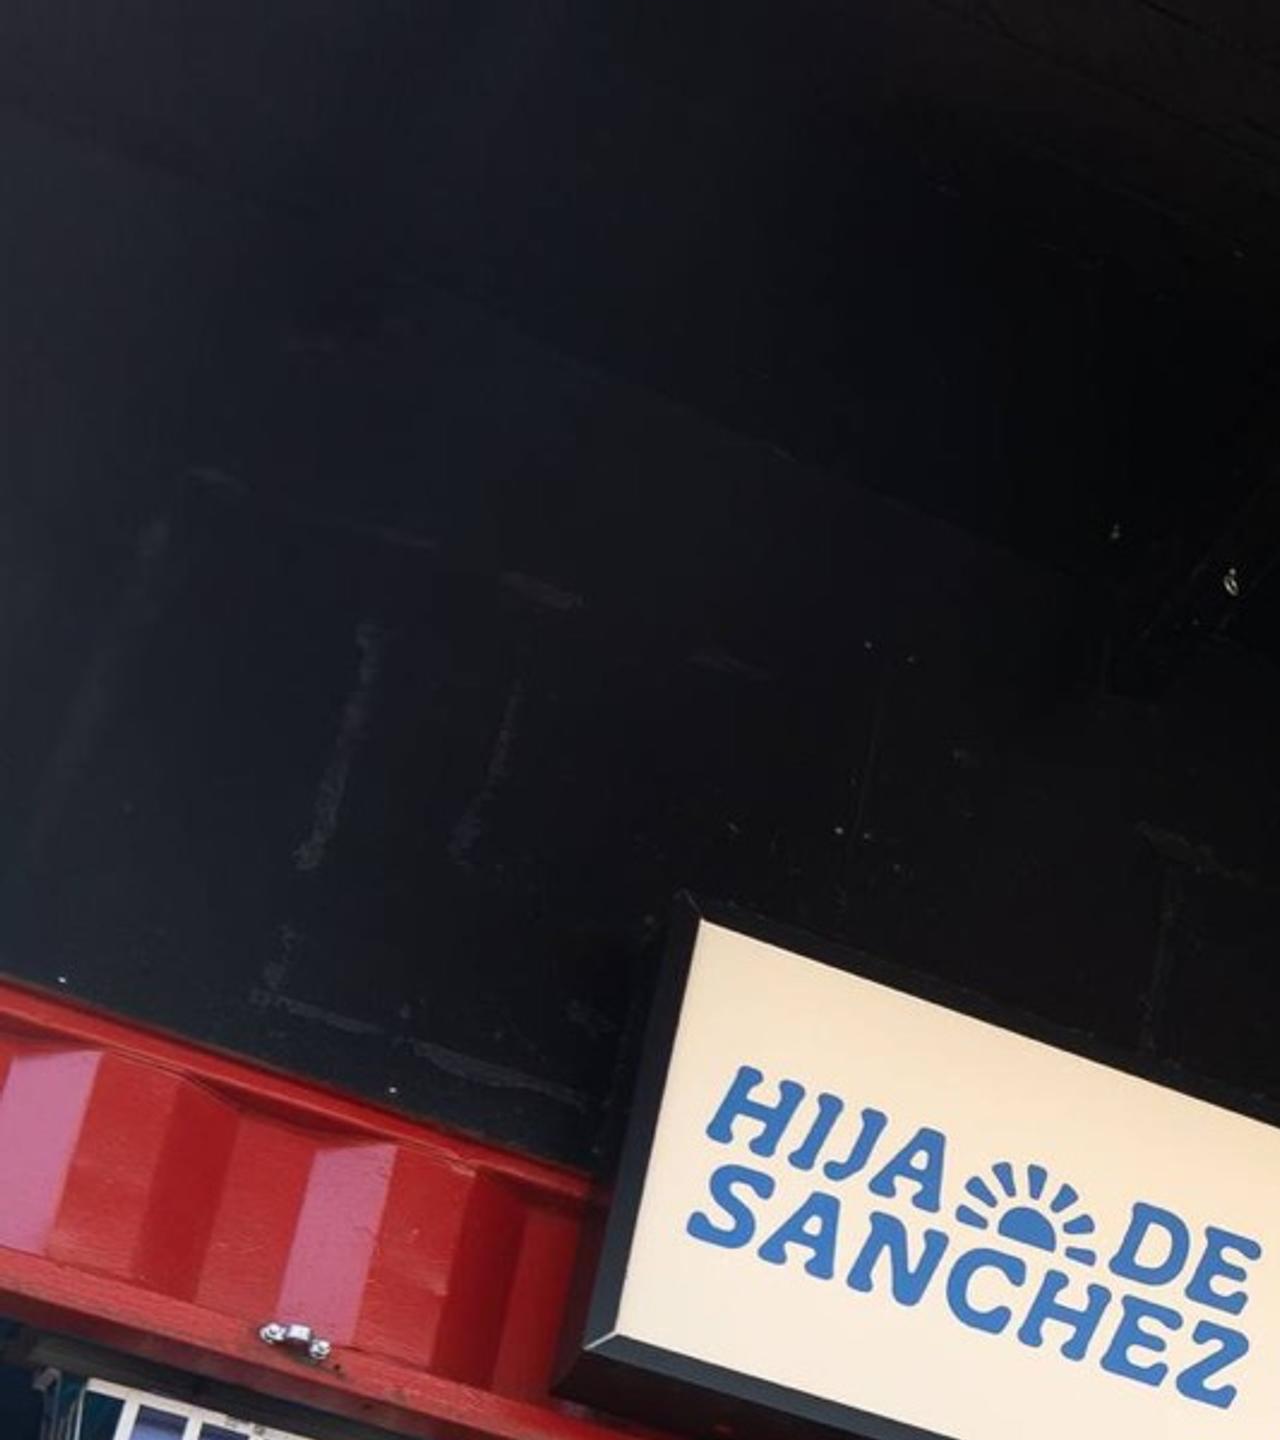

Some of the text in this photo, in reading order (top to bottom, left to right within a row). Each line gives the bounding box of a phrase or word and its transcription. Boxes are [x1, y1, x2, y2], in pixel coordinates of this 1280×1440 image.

[685, 1164, 1251, 1410] SANCHEZ
[705, 1065, 1263, 1316] HIJA DE
